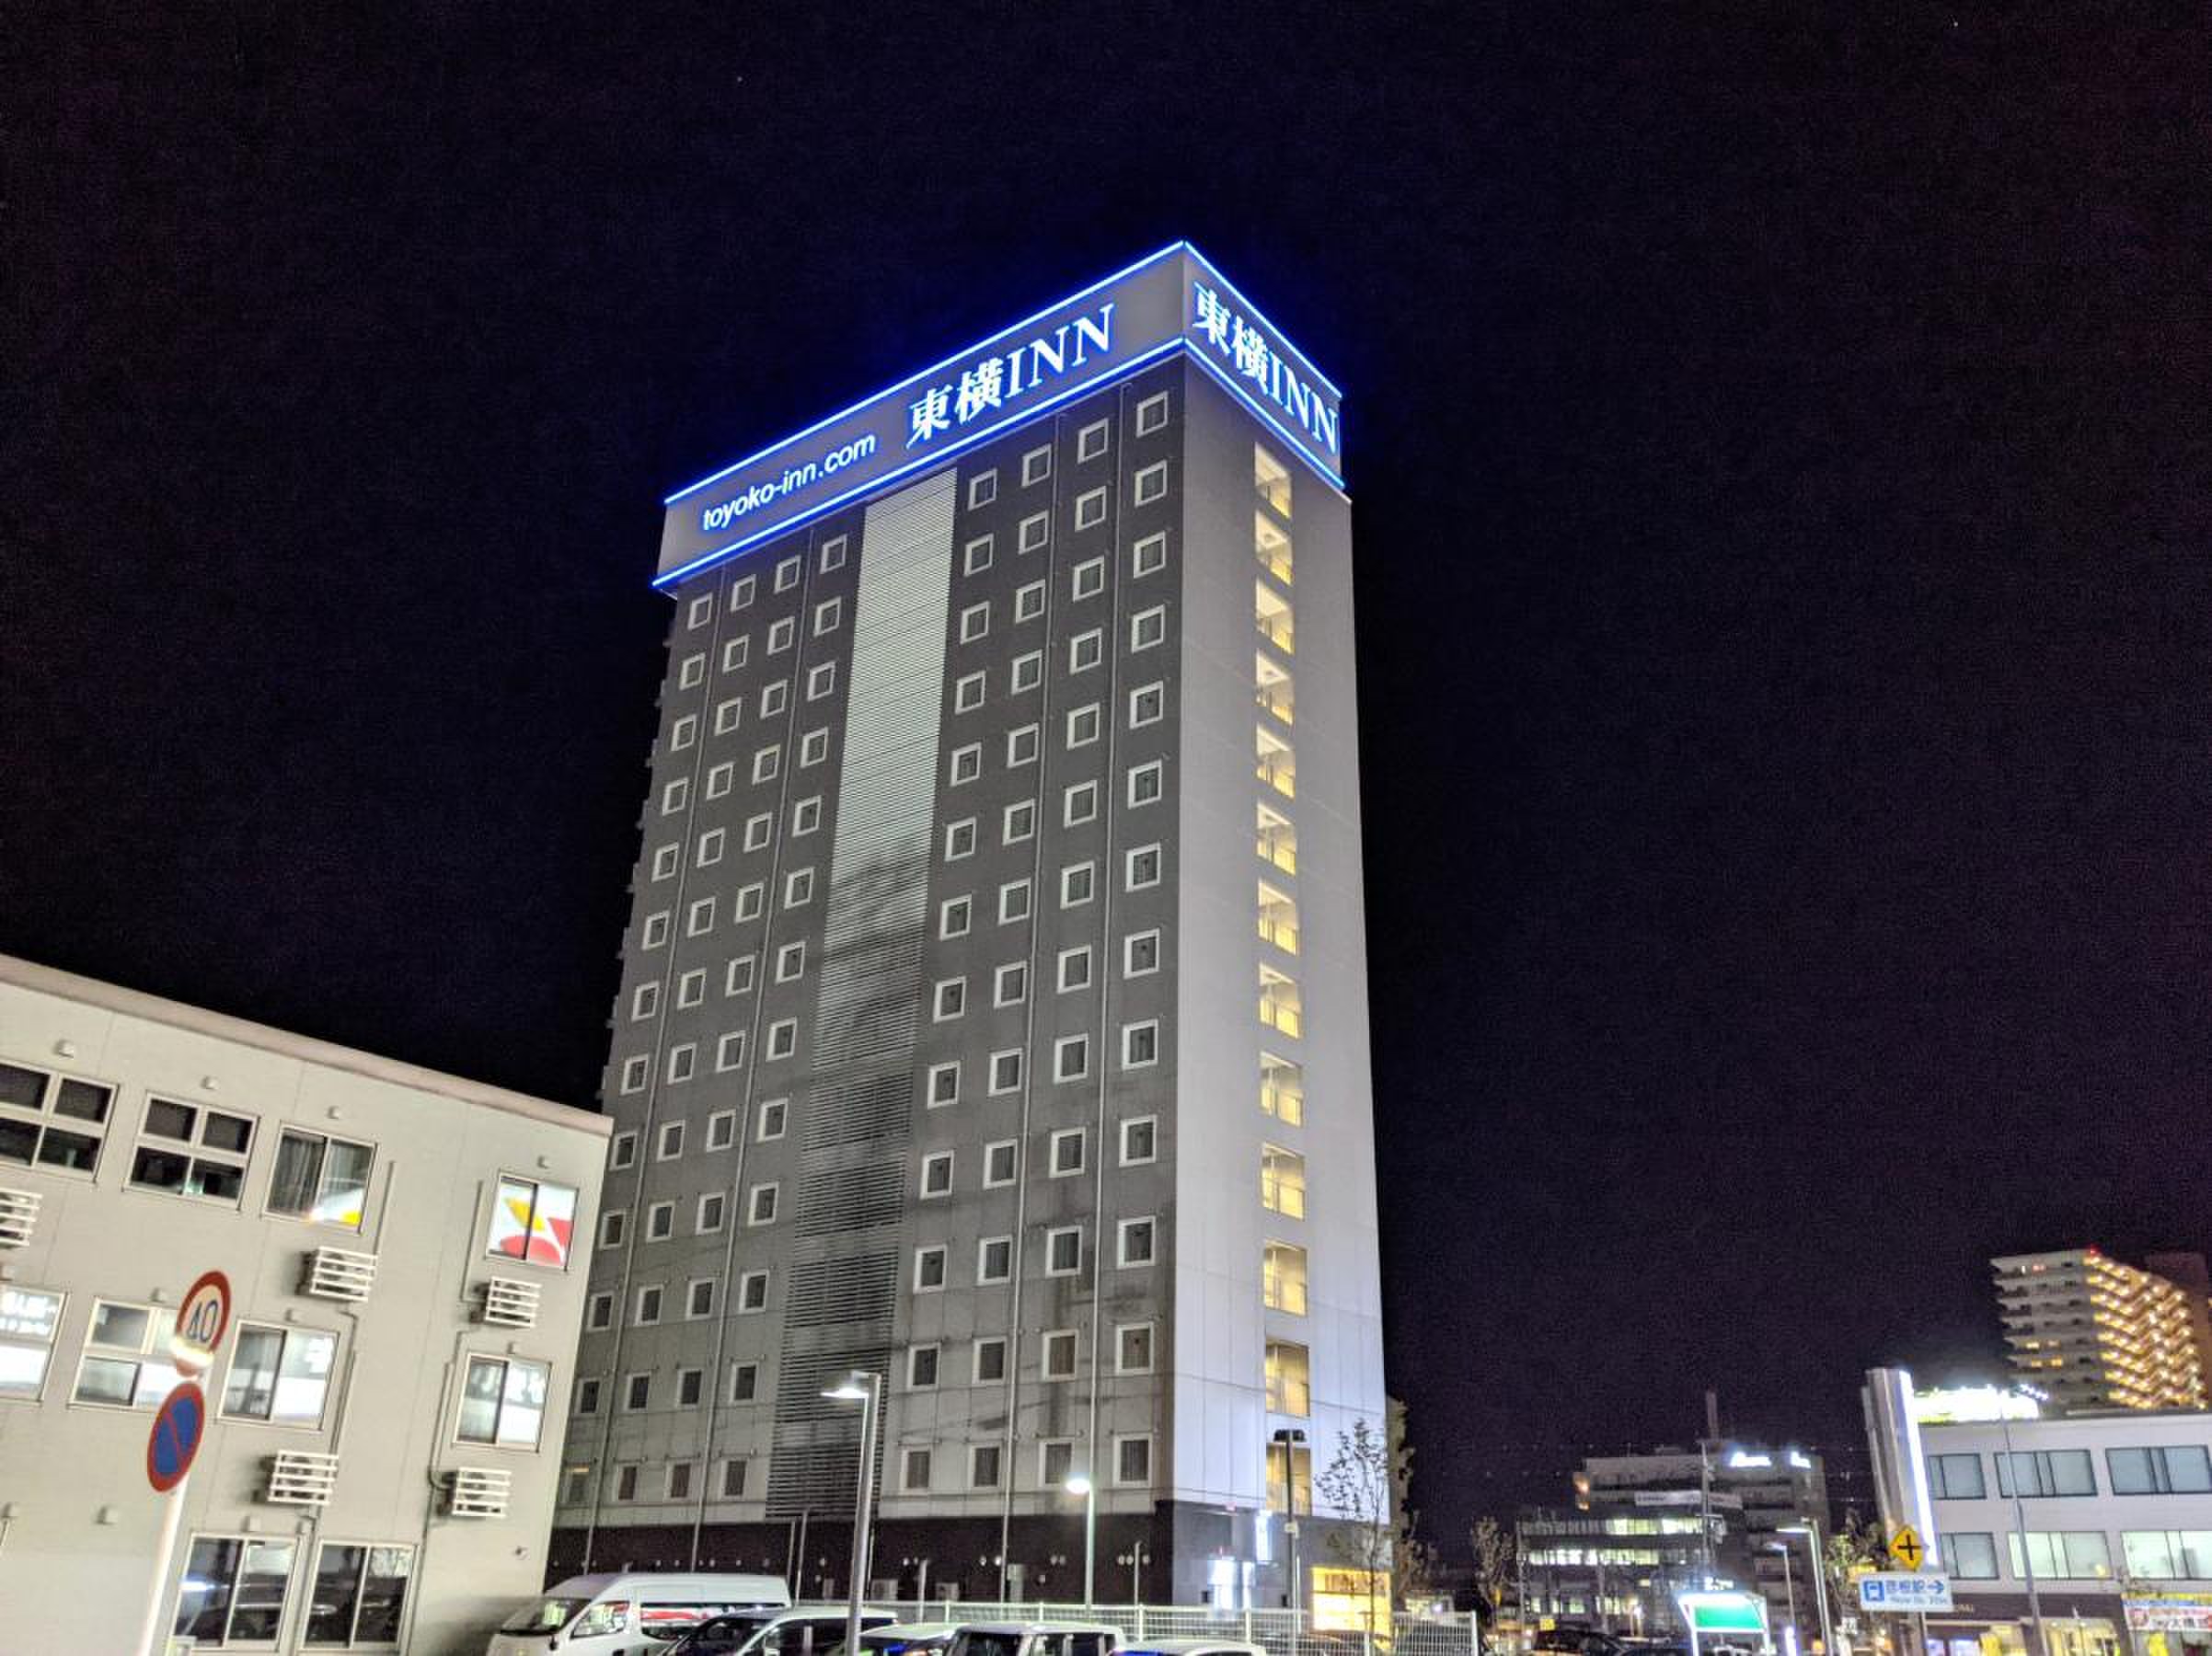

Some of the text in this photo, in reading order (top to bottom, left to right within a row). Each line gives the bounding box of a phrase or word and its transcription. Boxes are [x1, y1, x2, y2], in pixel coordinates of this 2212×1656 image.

[905, 303, 1115, 450] 東横INN
[1192, 282, 1338, 455] 東横INN
[703, 434, 876, 531] toyoko-inn.com
[187, 1299, 219, 1343] 40
